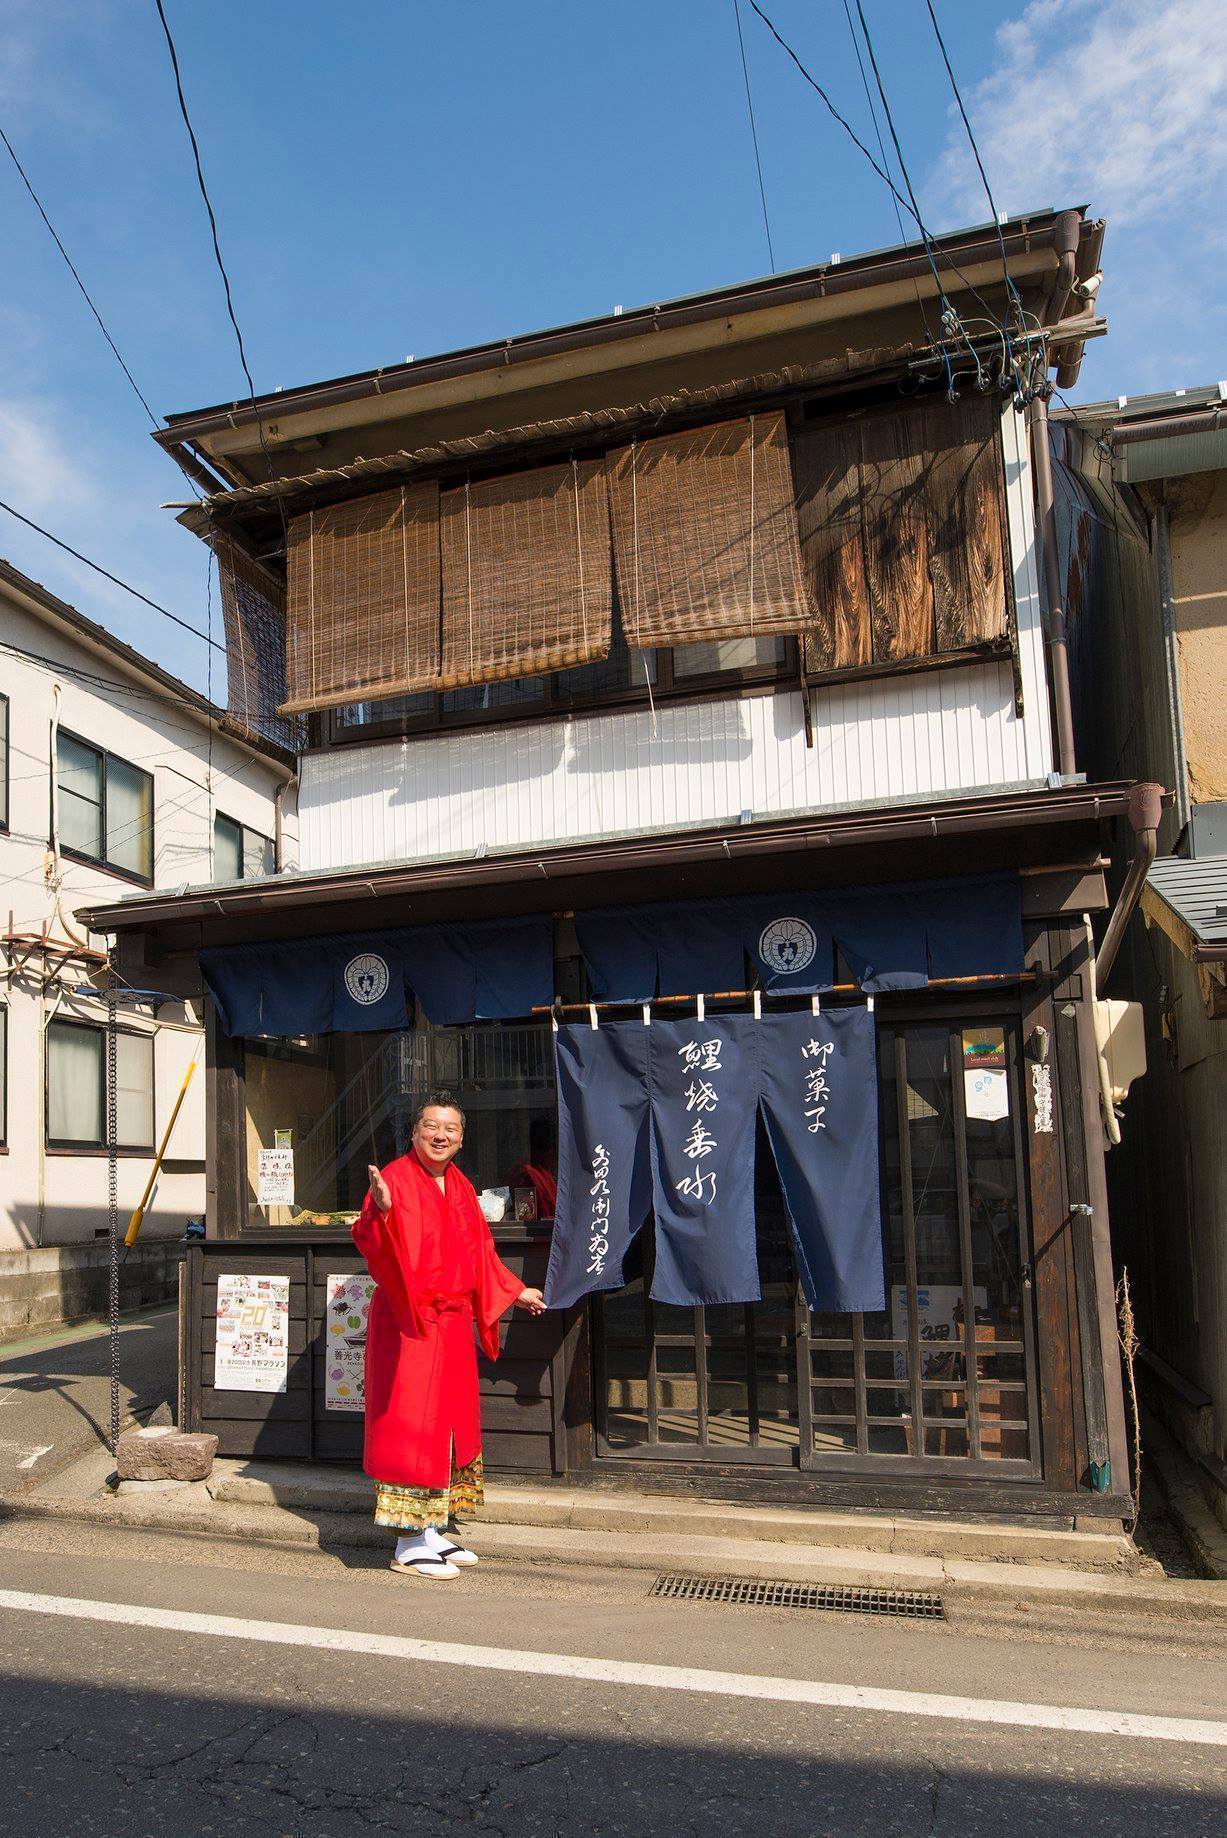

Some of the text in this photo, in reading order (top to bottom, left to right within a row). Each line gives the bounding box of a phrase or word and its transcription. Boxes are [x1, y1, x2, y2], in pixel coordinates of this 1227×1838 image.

[240, 1304, 269, 1328] 20
[334, 1350, 366, 1361] 善光寺
